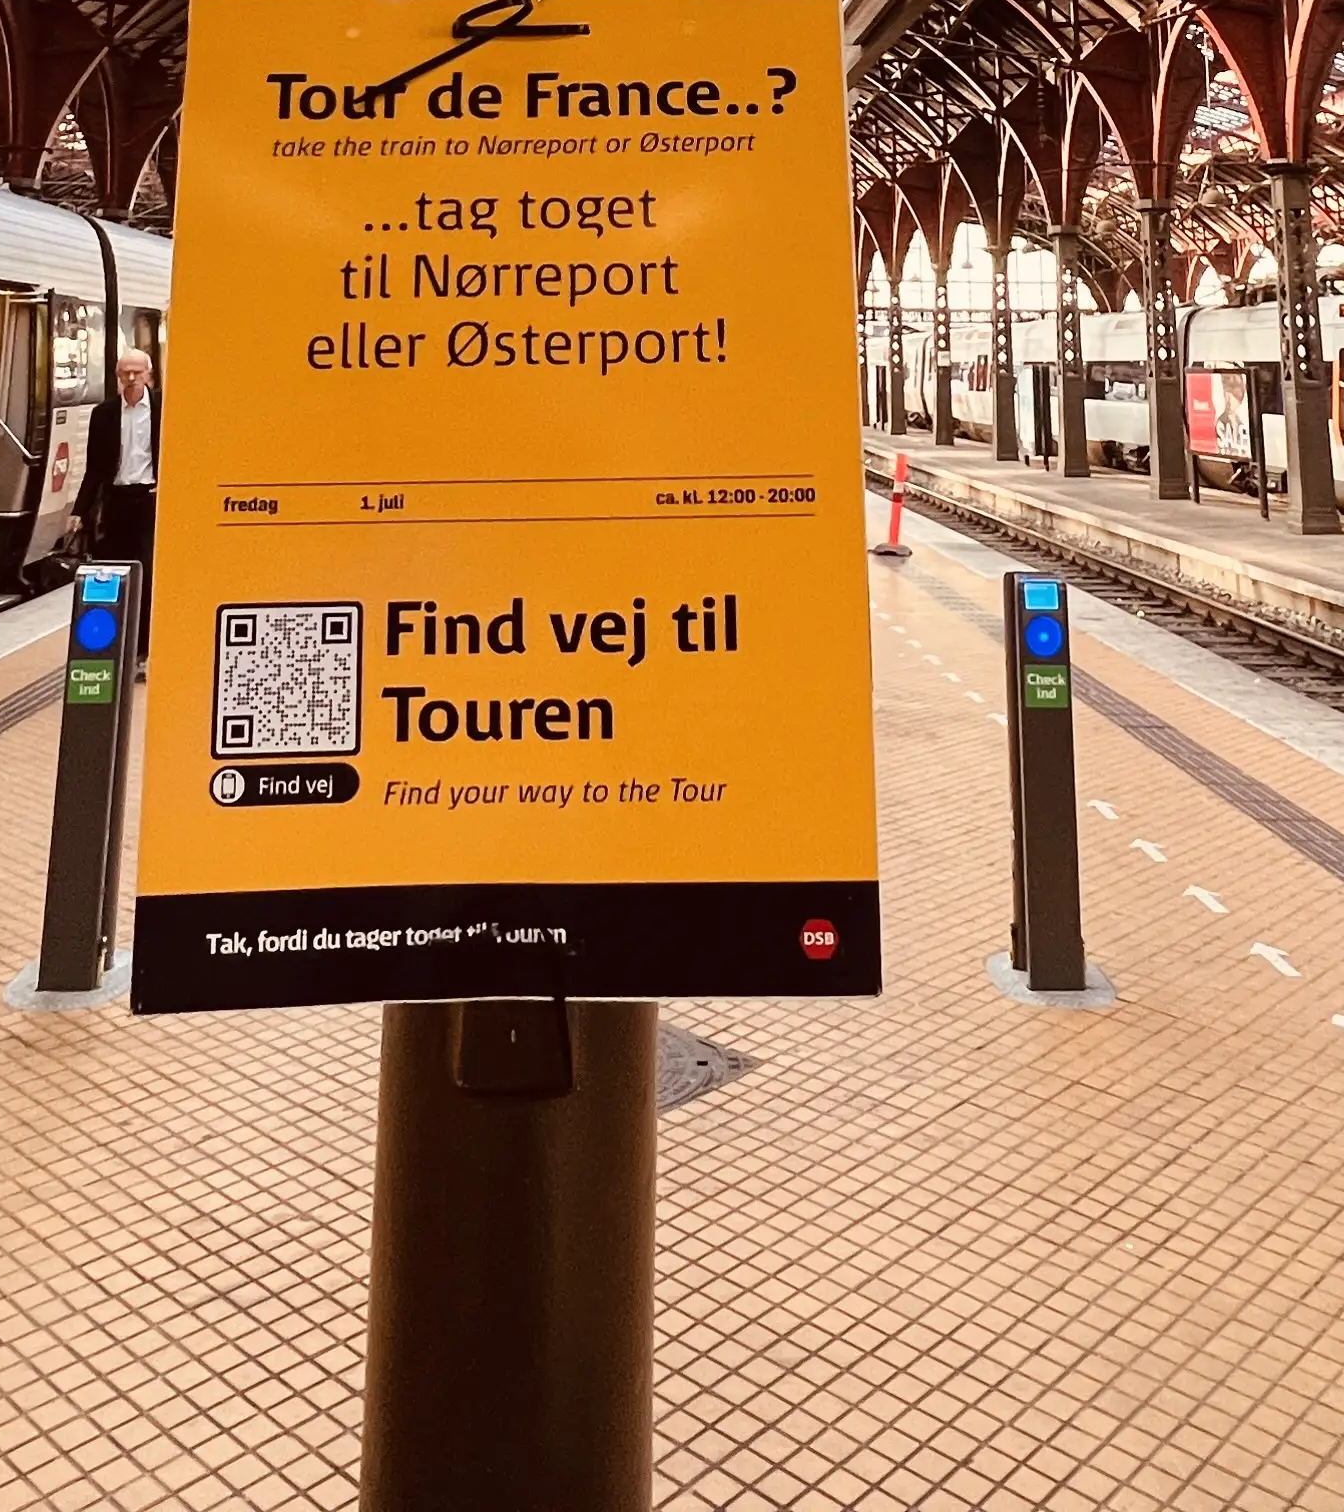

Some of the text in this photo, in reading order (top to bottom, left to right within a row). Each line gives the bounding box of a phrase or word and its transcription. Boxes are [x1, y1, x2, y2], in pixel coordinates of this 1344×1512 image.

[266, 66, 797, 120] Tour de France..?
[272, 132, 756, 159] take the train to Nørreport or Østerport
[364, 189, 657, 240] ...tag toget
[339, 253, 679, 307] til Nørreport
[307, 318, 726, 376] eller Østerport!
[223, 496, 278, 515] fredag
[360, 493, 404, 513] 1. juli
[656, 493, 679, 505] ca.
[682, 490, 703, 505] kl.
[707, 488, 756, 504] 12:00
[767, 487, 816, 503] 20:00
[386, 594, 738, 668] Find vej til
[70, 669, 111, 682] Check
[1027, 673, 1066, 686] Check
[79, 683, 100, 696] ind
[1037, 688, 1057, 699] ind
[381, 686, 614, 743] Touren
[258, 775, 333, 799] Find vej
[384, 777, 728, 810] Find your way to the Tour
[205, 931, 253, 956] Tak,
[257, 928, 308, 952] fordi
[312, 927, 341, 951] du
[344, 928, 402, 951] tager
[803, 931, 835, 946] DSB
